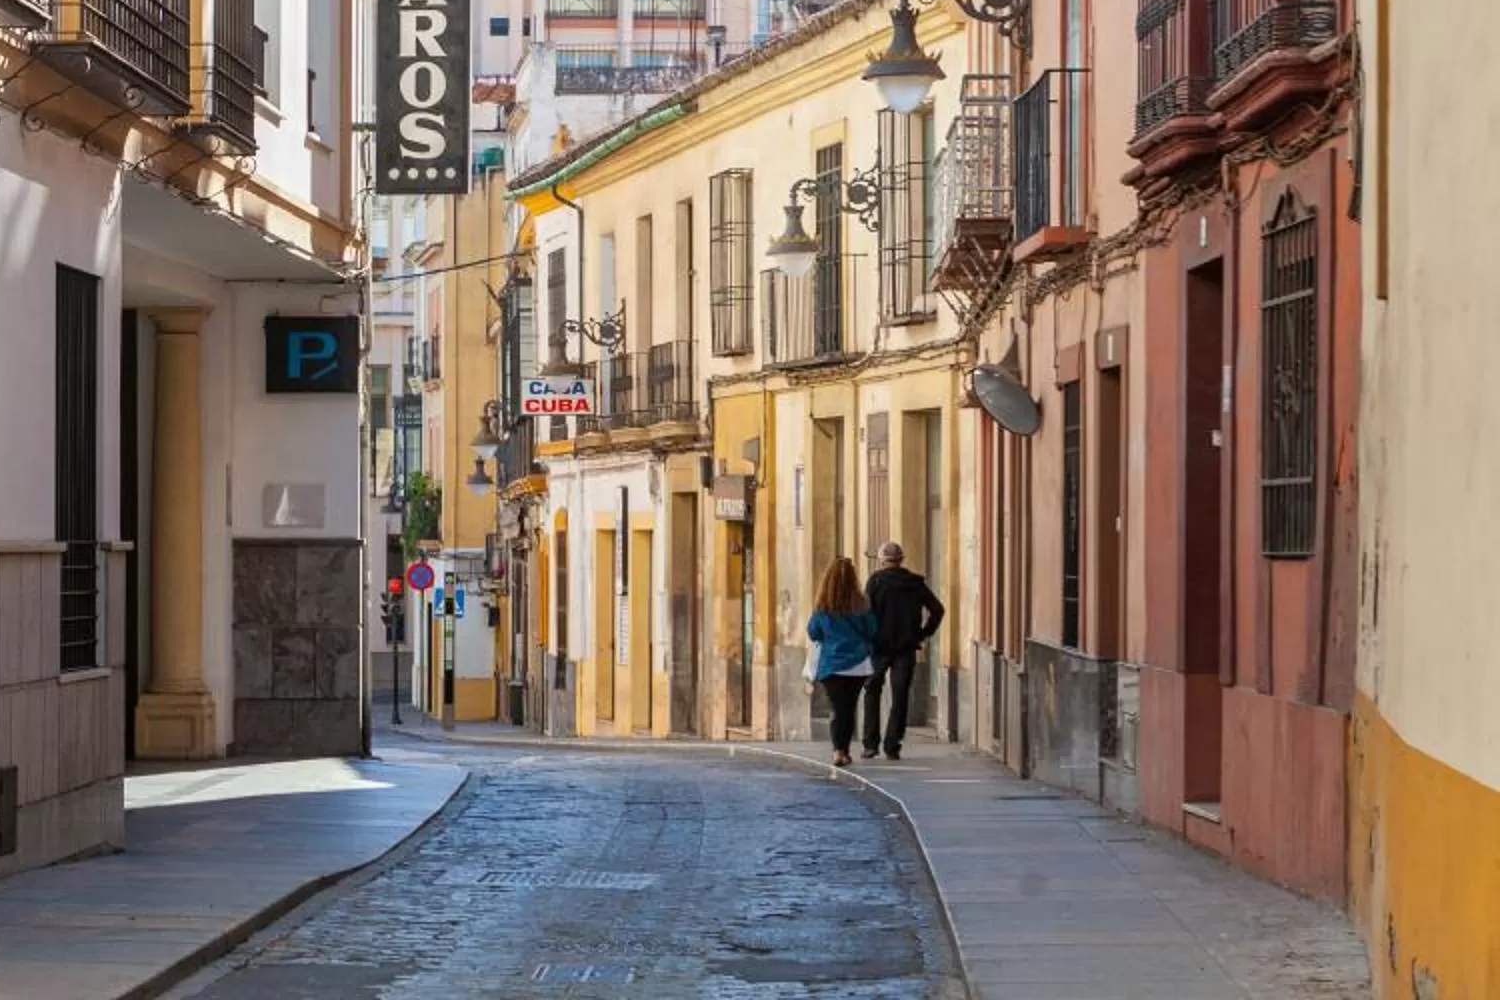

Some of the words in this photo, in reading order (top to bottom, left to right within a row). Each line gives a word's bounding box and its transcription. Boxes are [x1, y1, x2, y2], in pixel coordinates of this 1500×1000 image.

[287, 331, 338, 378] P
[529, 381, 586, 395] CAA
[525, 399, 589, 413] CUBA
